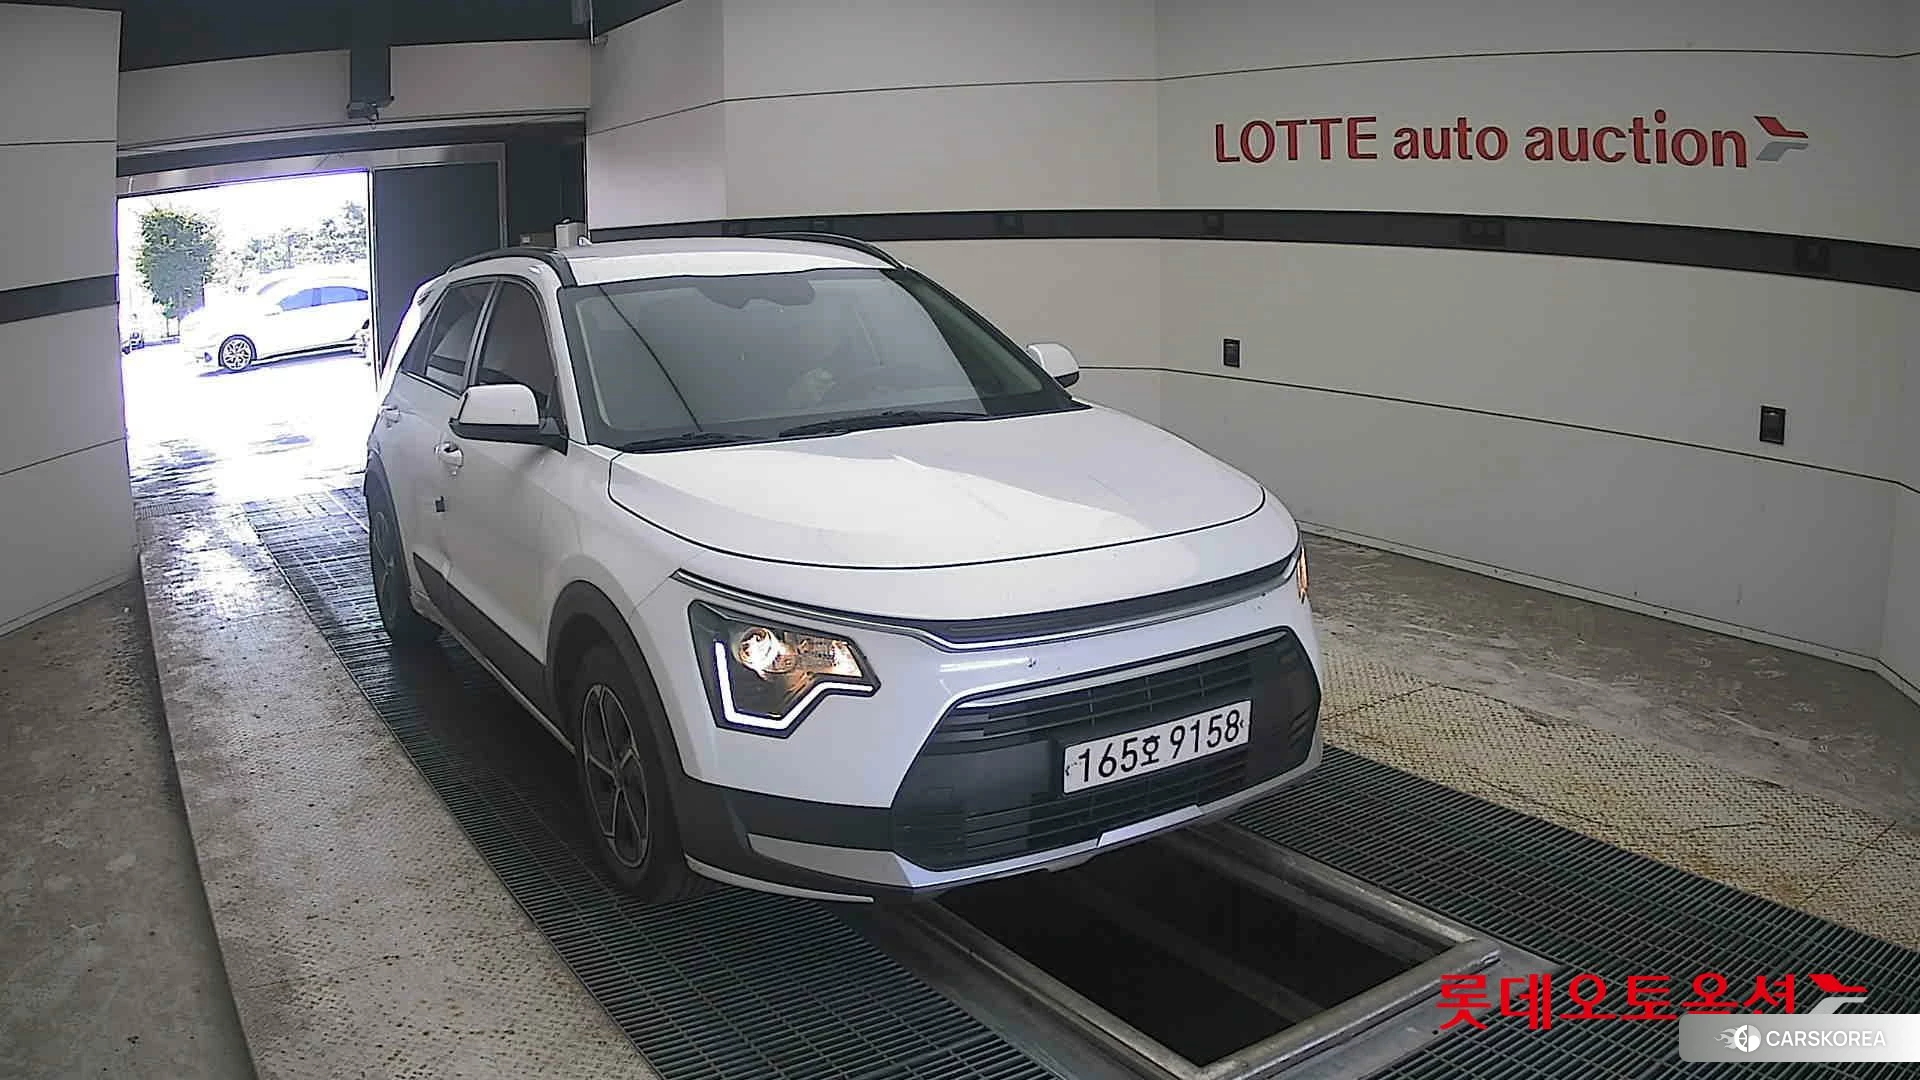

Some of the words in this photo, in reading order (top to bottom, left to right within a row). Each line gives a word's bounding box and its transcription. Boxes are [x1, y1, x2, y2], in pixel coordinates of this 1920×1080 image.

[1215, 116, 1377, 163] LOTTE
[1393, 117, 1509, 161] auto
[1525, 109, 1748, 168] auction
[1078, 736, 1160, 782] 165호
[1169, 709, 1241, 759] 9158
